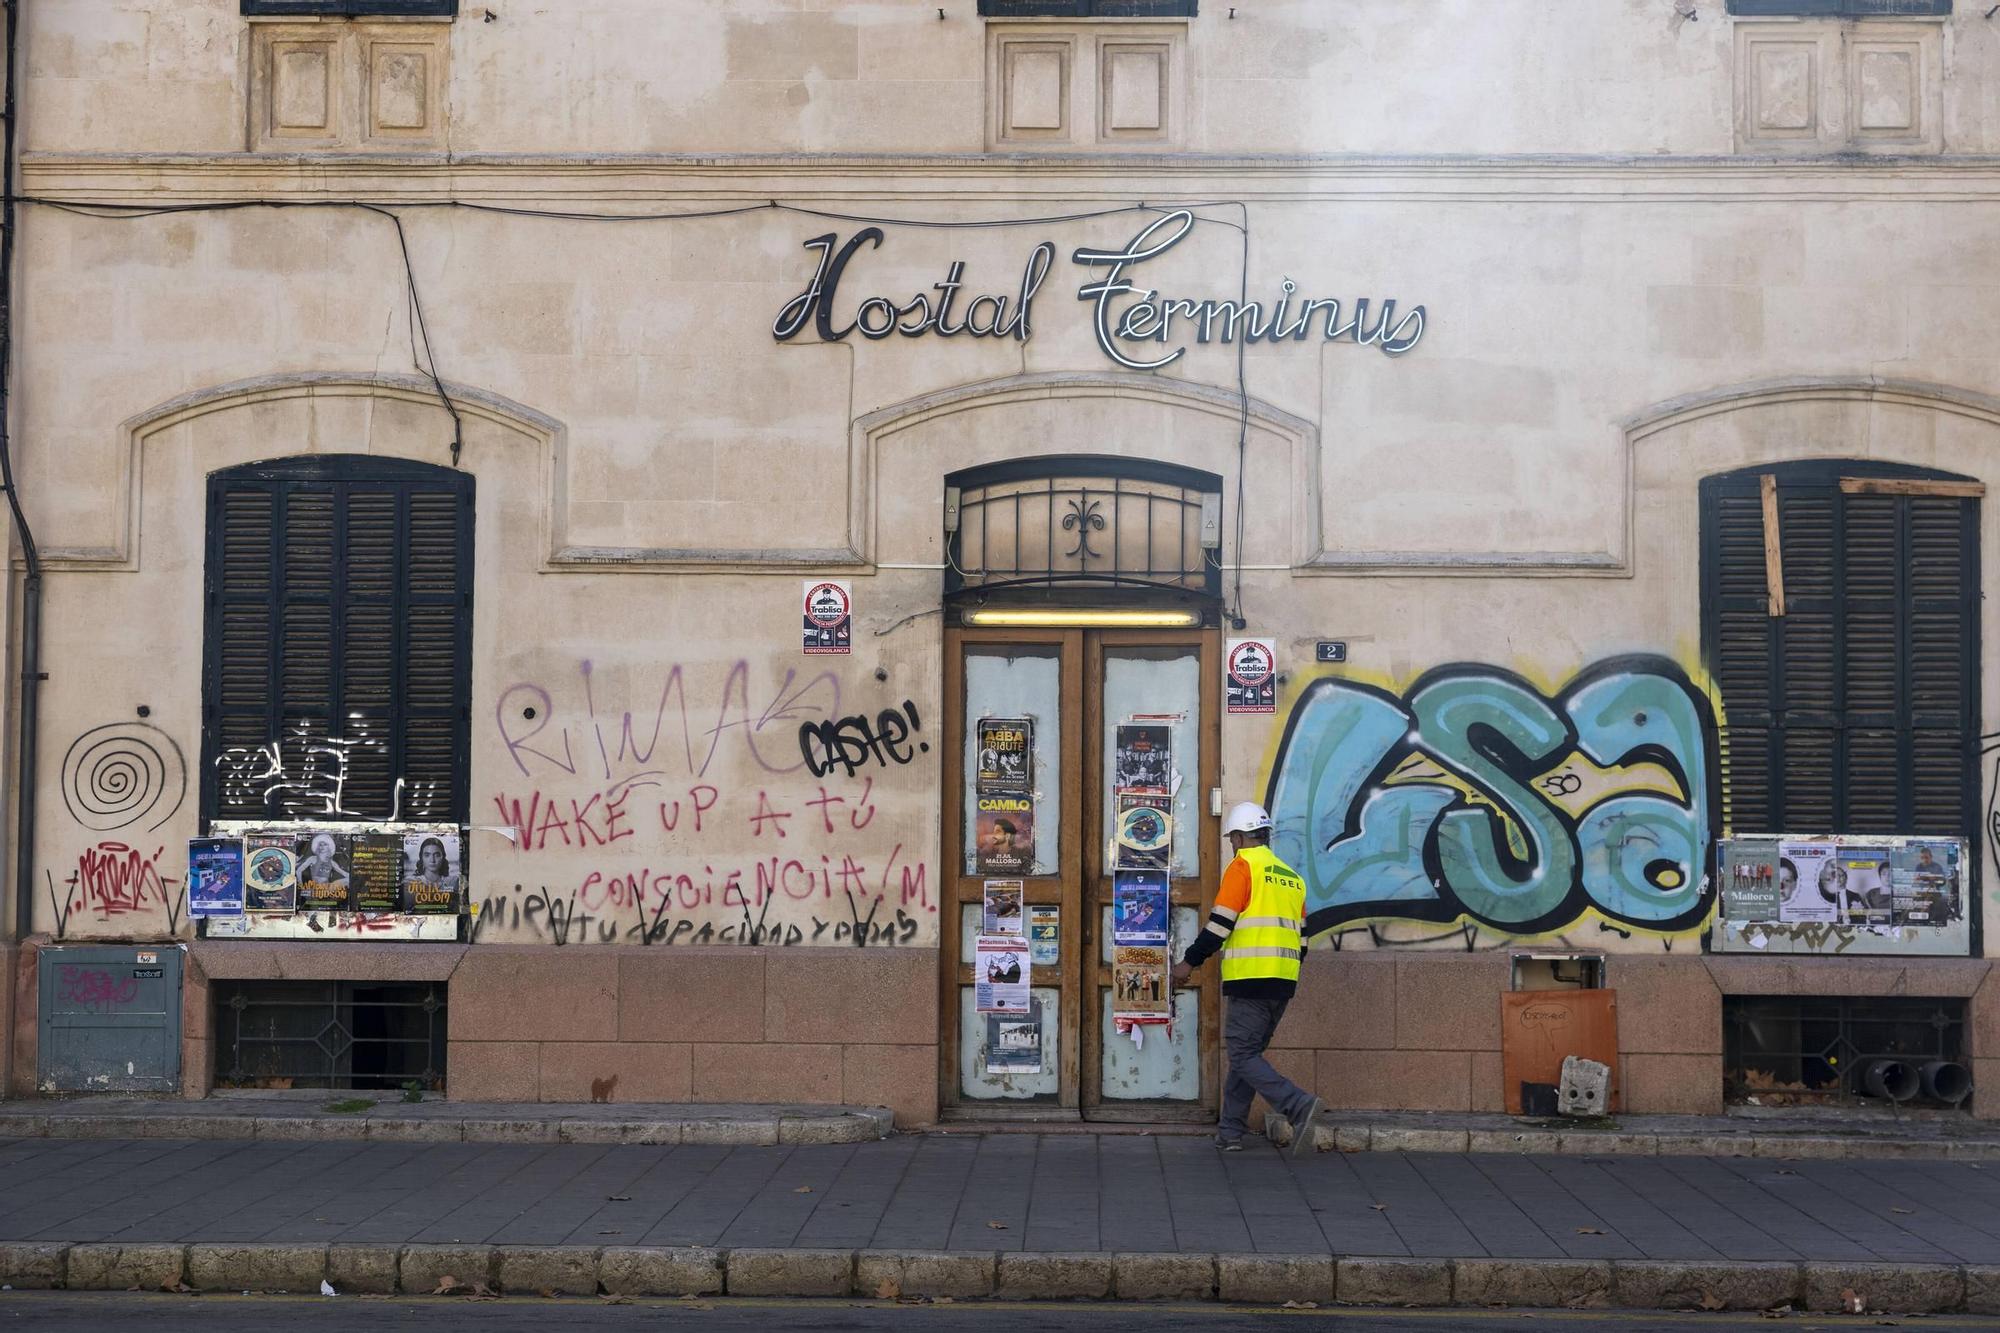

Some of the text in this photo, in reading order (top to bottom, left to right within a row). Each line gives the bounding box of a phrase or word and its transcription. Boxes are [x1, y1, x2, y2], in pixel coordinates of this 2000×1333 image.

[772, 227, 1055, 342] Hostal
[1326, 645, 1337, 658] 2
[1235, 664, 1267, 672] Trablisa
[985, 731, 1024, 741] ABBA
[986, 742, 1024, 751] TRIBUTE
[979, 799, 1030, 811] CAMILO
[494, 788, 635, 851] WAKE
[660, 786, 718, 832] UP
[750, 791, 792, 837] A
[408, 880, 439, 893] JULIA
[1265, 875, 1302, 890] RIGEL
[312, 889, 347, 899] HUDSON
[415, 892, 450, 904] COLOM
[1731, 891, 1774, 901] Mallorca
